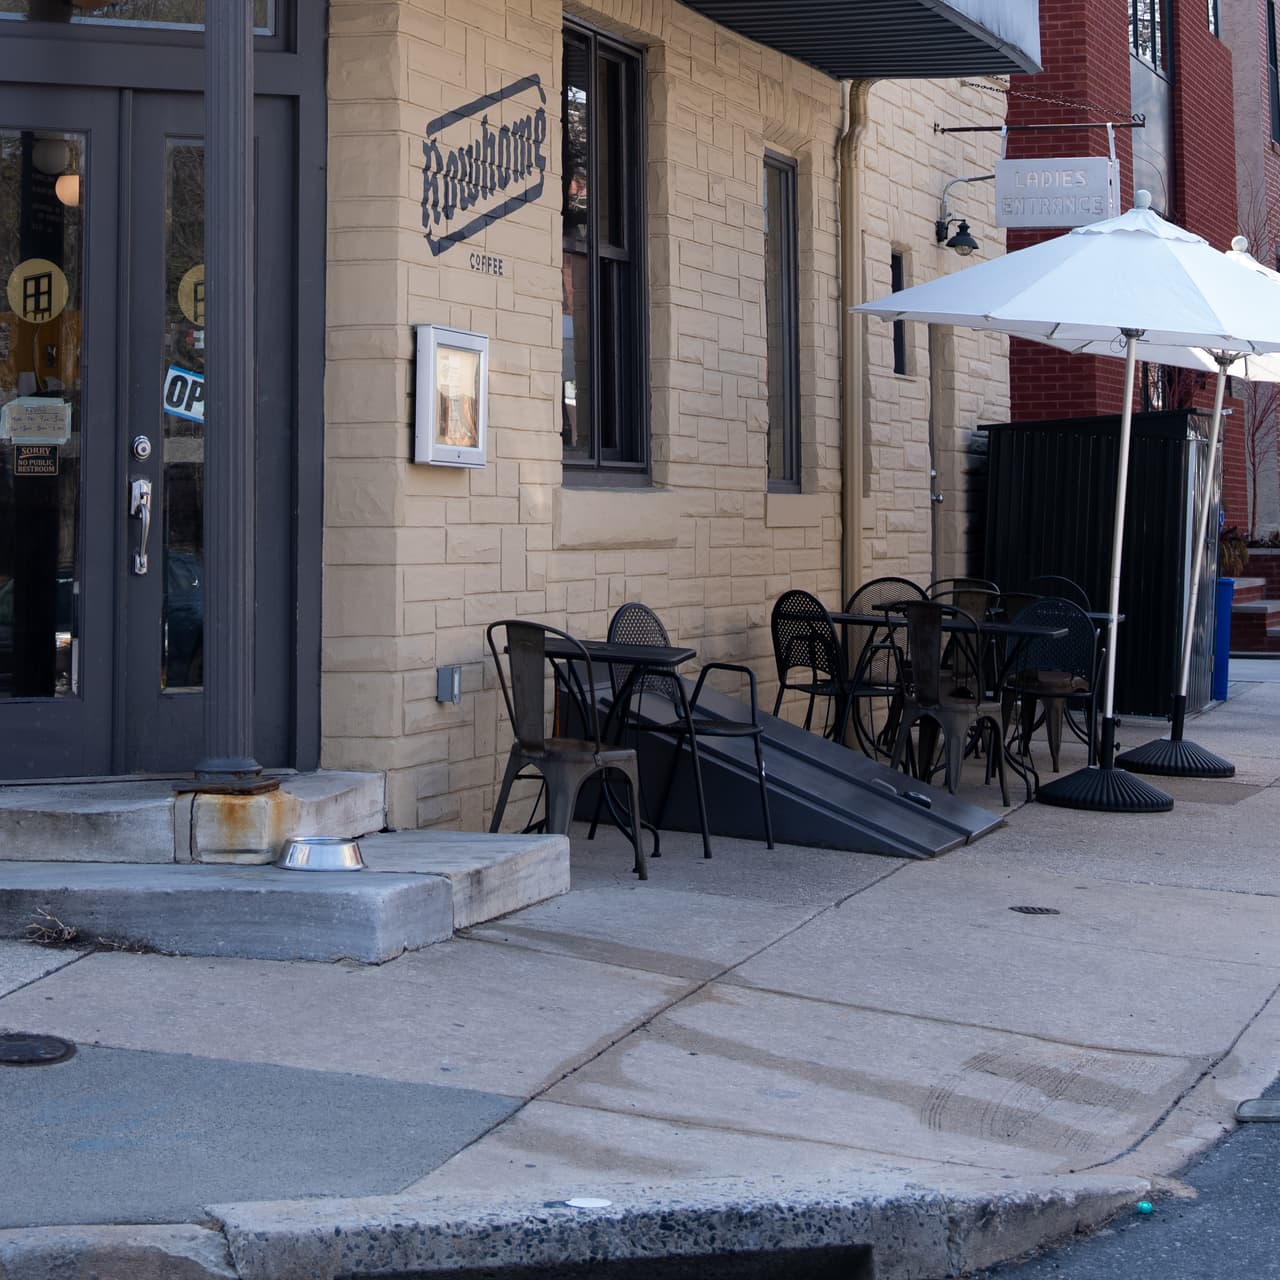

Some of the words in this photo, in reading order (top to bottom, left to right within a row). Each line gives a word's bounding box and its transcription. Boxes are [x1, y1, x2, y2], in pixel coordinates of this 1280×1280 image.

[421, 106, 548, 228] Rowhome
[1015, 170, 1088, 188] LADIES
[1001, 195, 1105, 216] ENTRANCE
[469, 251, 504, 276] COFFEE
[21, 446, 51, 456] SORRY
